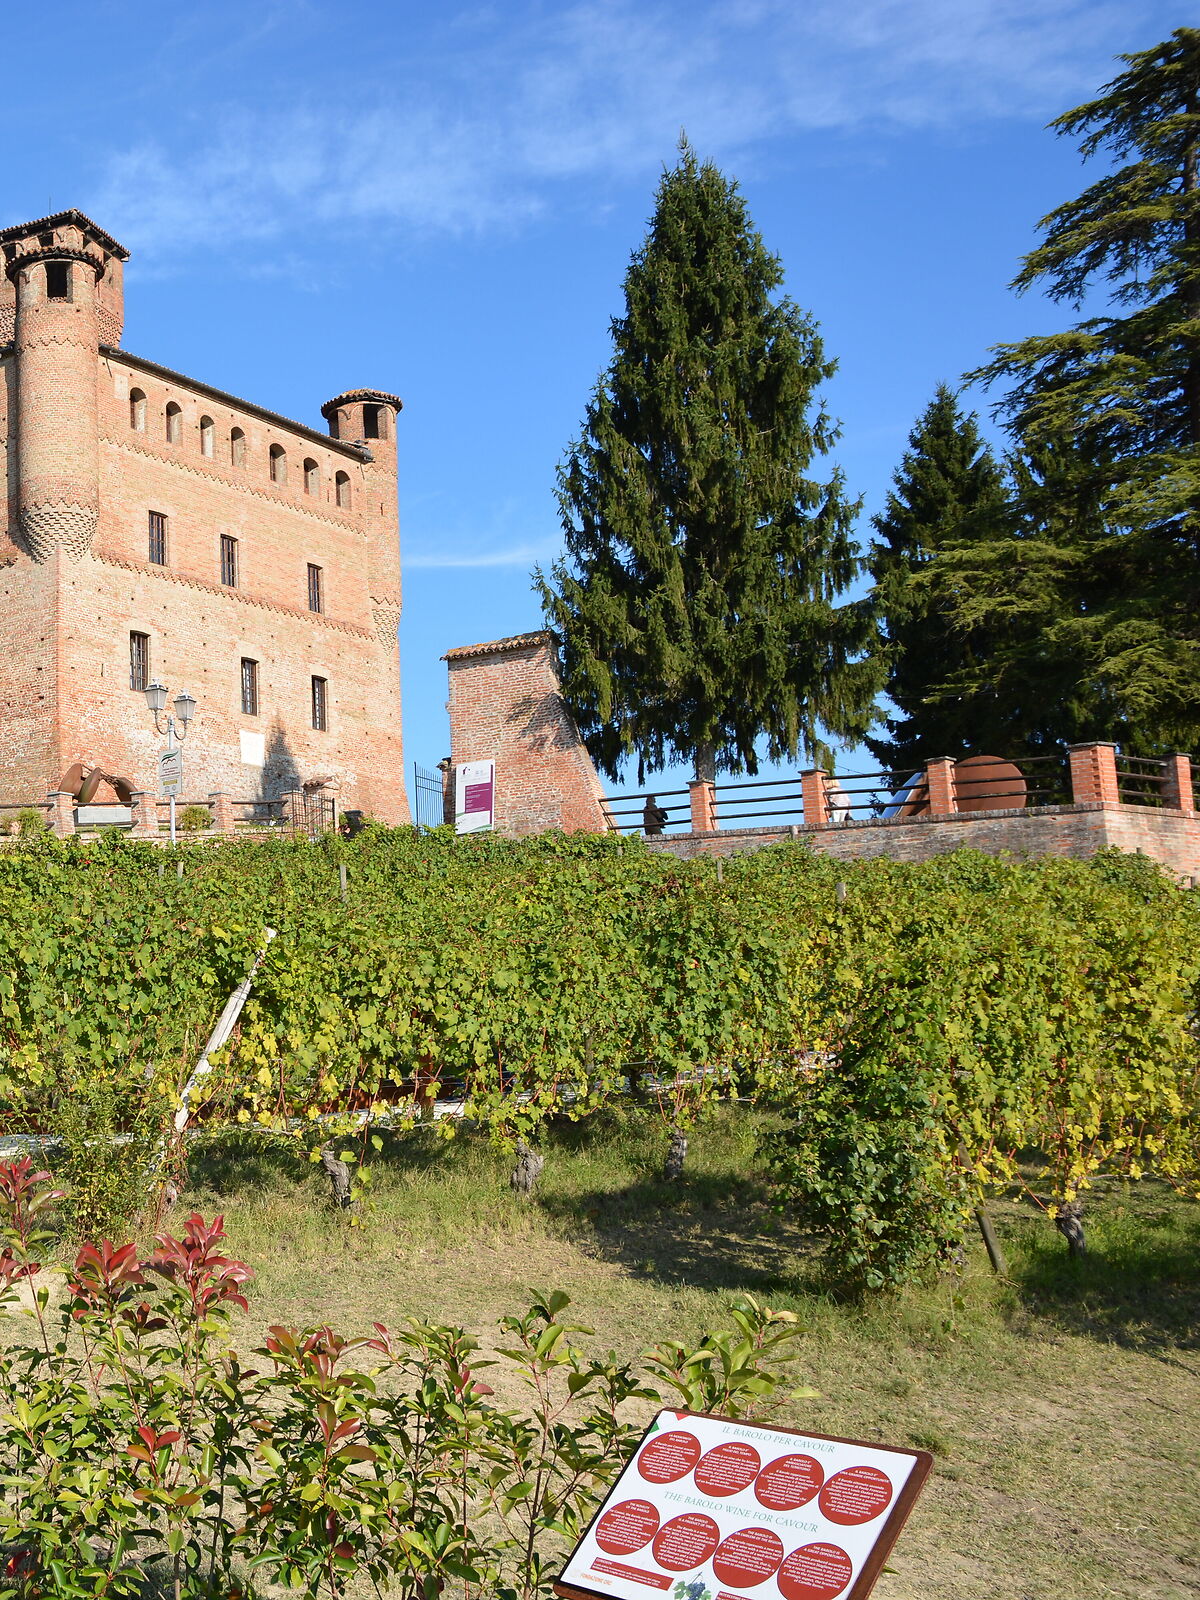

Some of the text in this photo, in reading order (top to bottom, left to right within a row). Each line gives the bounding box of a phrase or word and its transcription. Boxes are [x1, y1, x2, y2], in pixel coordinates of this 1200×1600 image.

[734, 1428, 771, 1440] BAROLO
[773, 1436, 791, 1445] PER
[794, 1439, 835, 1452] CAVOUR
[664, 1491, 818, 1532] THE BAROLO WINE FOR CAVOUR
